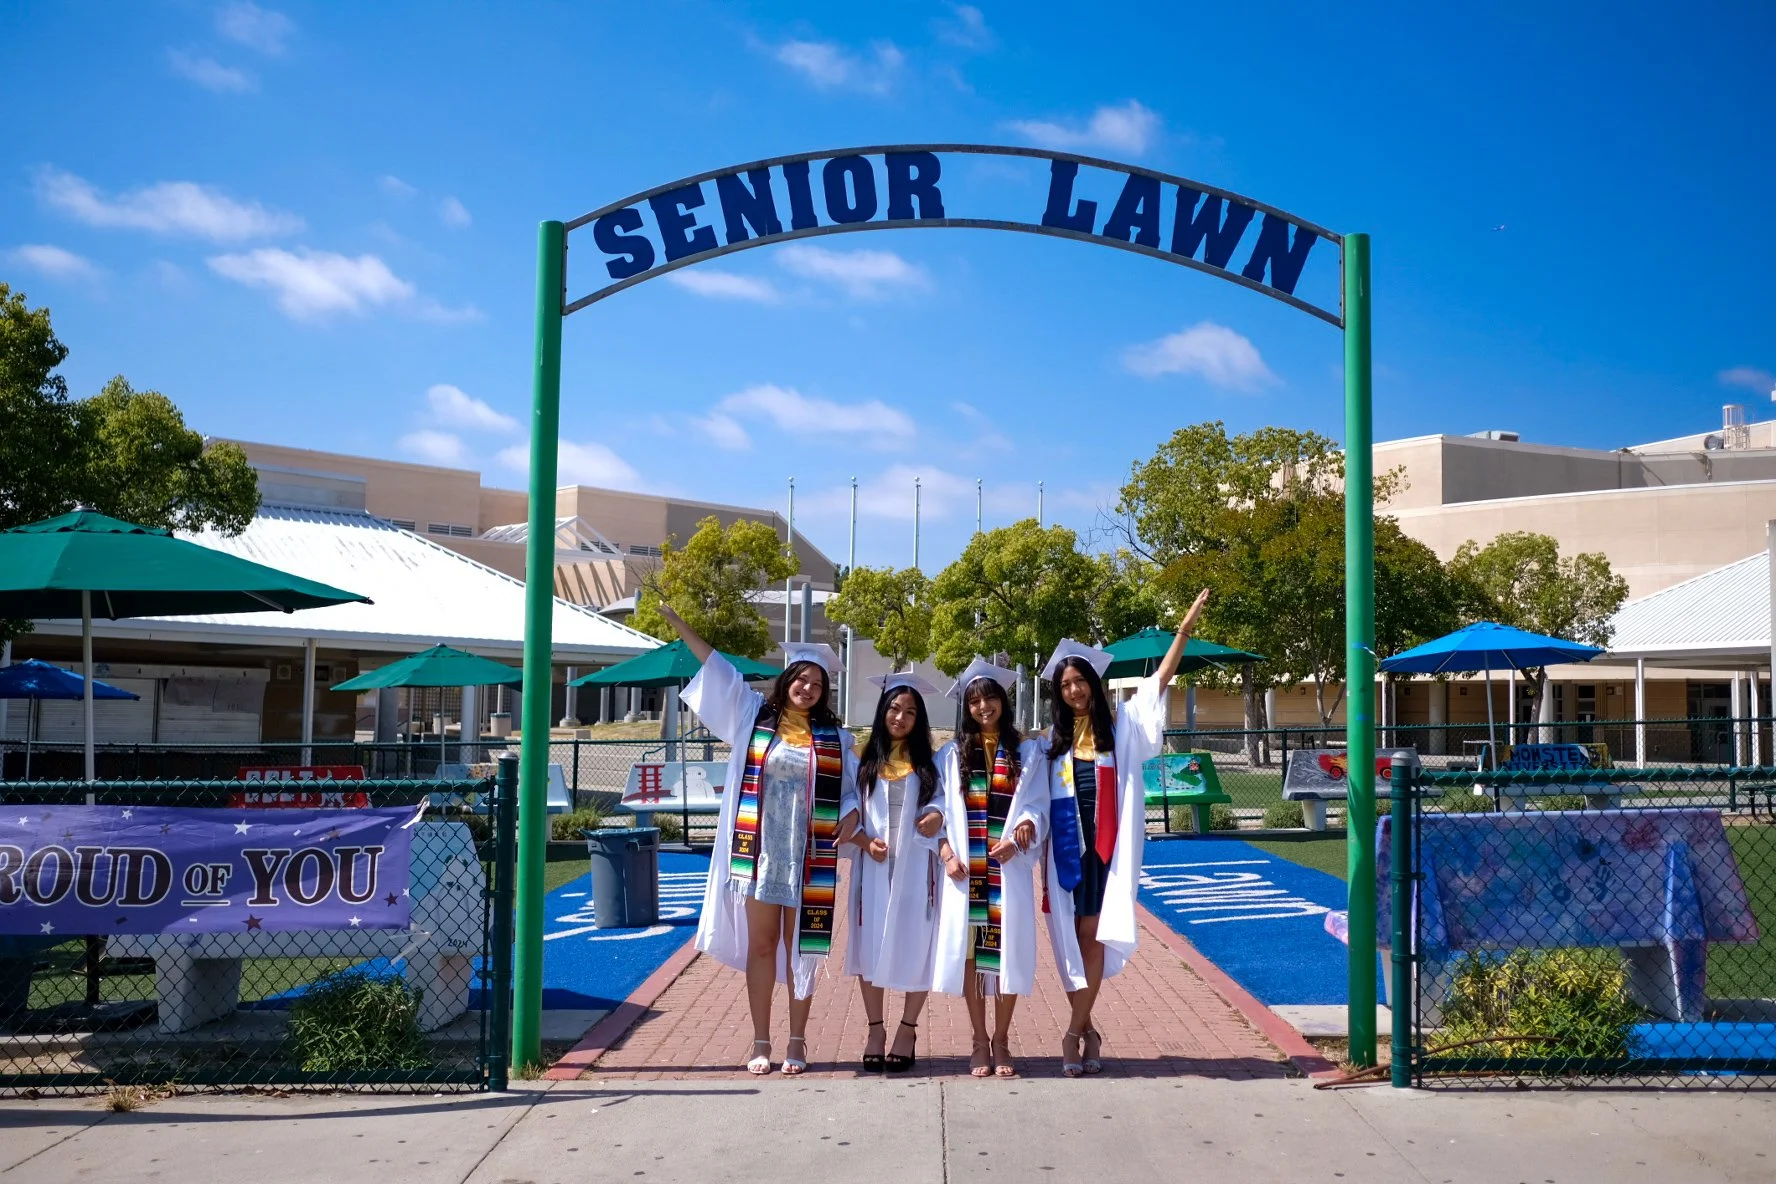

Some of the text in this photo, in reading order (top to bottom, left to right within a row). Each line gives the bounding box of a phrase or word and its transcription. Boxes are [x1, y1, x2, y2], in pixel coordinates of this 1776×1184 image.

[592, 151, 1318, 295] SENIOR LAWN
[737, 833, 753, 841] CLASS
[738, 846, 749, 854] 2024
[181, 863, 232, 896] OF
[241, 846, 385, 906] YOU
